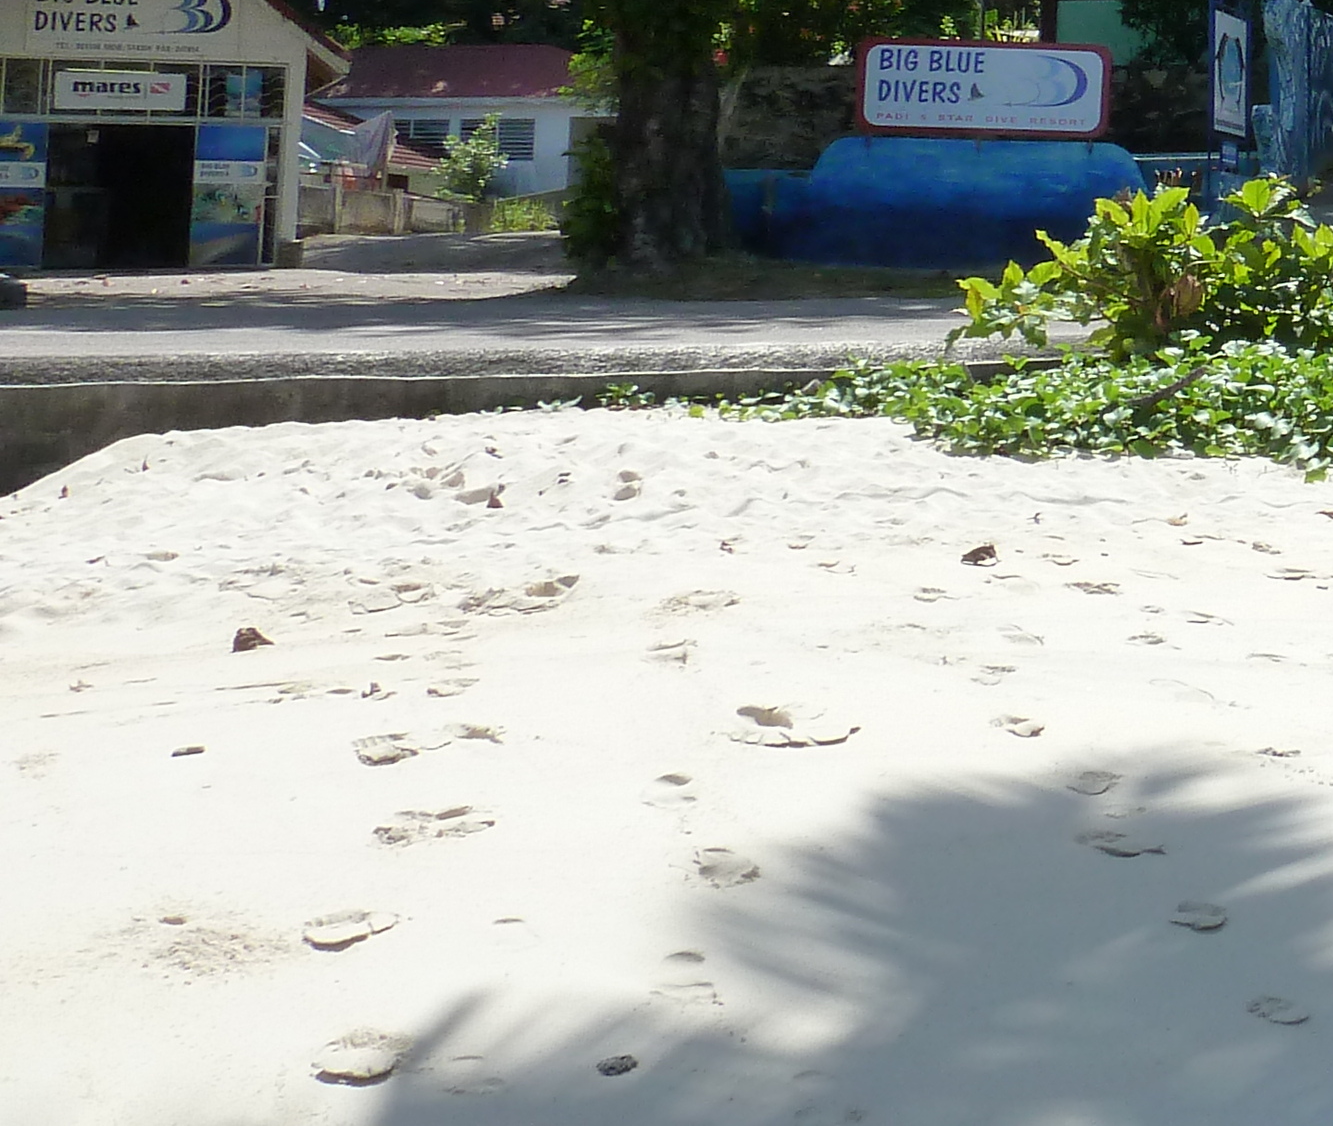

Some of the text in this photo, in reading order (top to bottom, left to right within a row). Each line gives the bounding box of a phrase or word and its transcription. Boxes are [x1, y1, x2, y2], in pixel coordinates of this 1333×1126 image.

[35, 11, 117, 32] DIVERS
[880, 49, 985, 73] BIG BLUE
[72, 81, 141, 93] mares
[878, 80, 962, 103] DIVERS
[876, 112, 909, 120] PADI
[938, 114, 974, 122] STAR
[985, 116, 1018, 124] DIVE
[1029, 117, 1085, 126] RESORT
